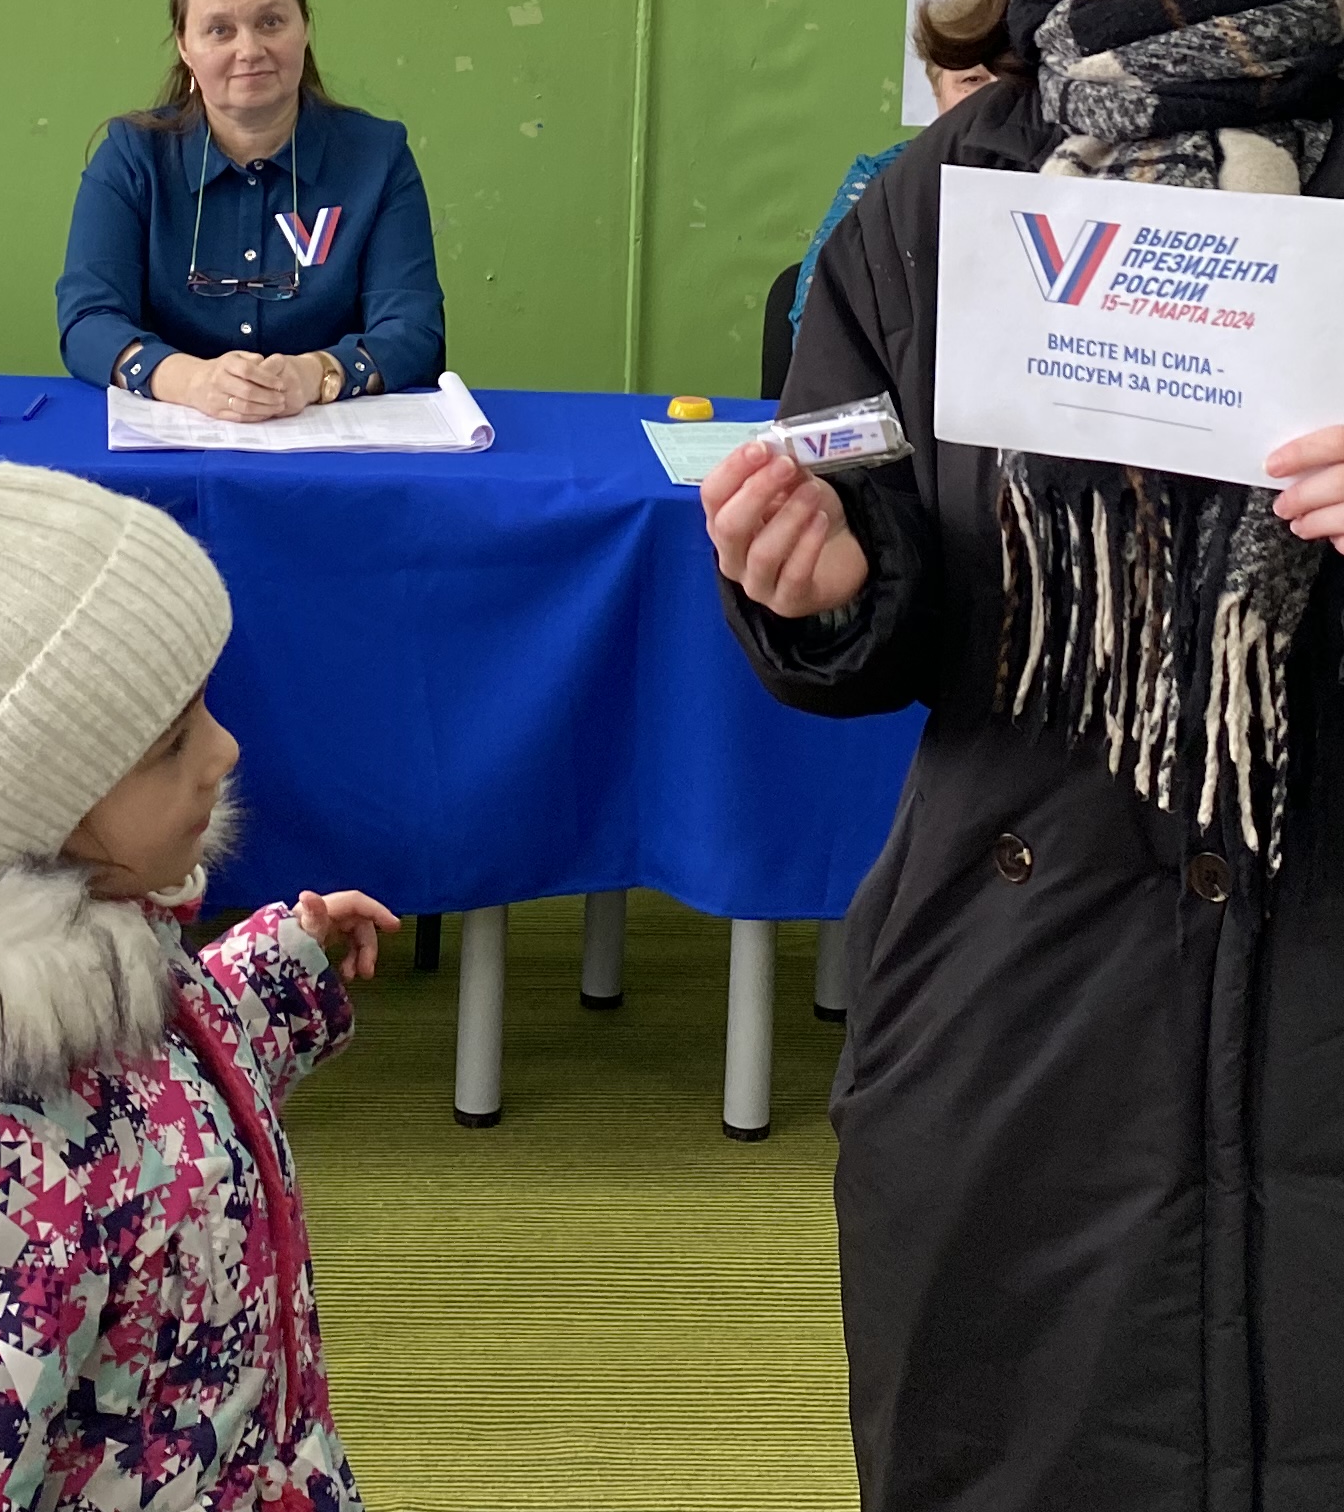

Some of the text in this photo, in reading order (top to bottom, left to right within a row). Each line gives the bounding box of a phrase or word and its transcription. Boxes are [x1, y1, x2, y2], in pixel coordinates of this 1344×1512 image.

[1132, 226, 1239, 256] ВЫБОРЫ
[1120, 247, 1280, 284] ПРЕЗИДЕНТА
[1109, 272, 1211, 303] РОССИИ
[1148, 301, 1210, 325] МАРТА
[1211, 308, 1256, 331] 2024
[1047, 332, 1119, 361] ВМЕСТЕ
[1123, 345, 1156, 367] МЫ
[1162, 351, 1212, 376] СИЛА
[1027, 357, 1243, 409] ГОЛОСУЕМ ЗА РОССИЮ!
